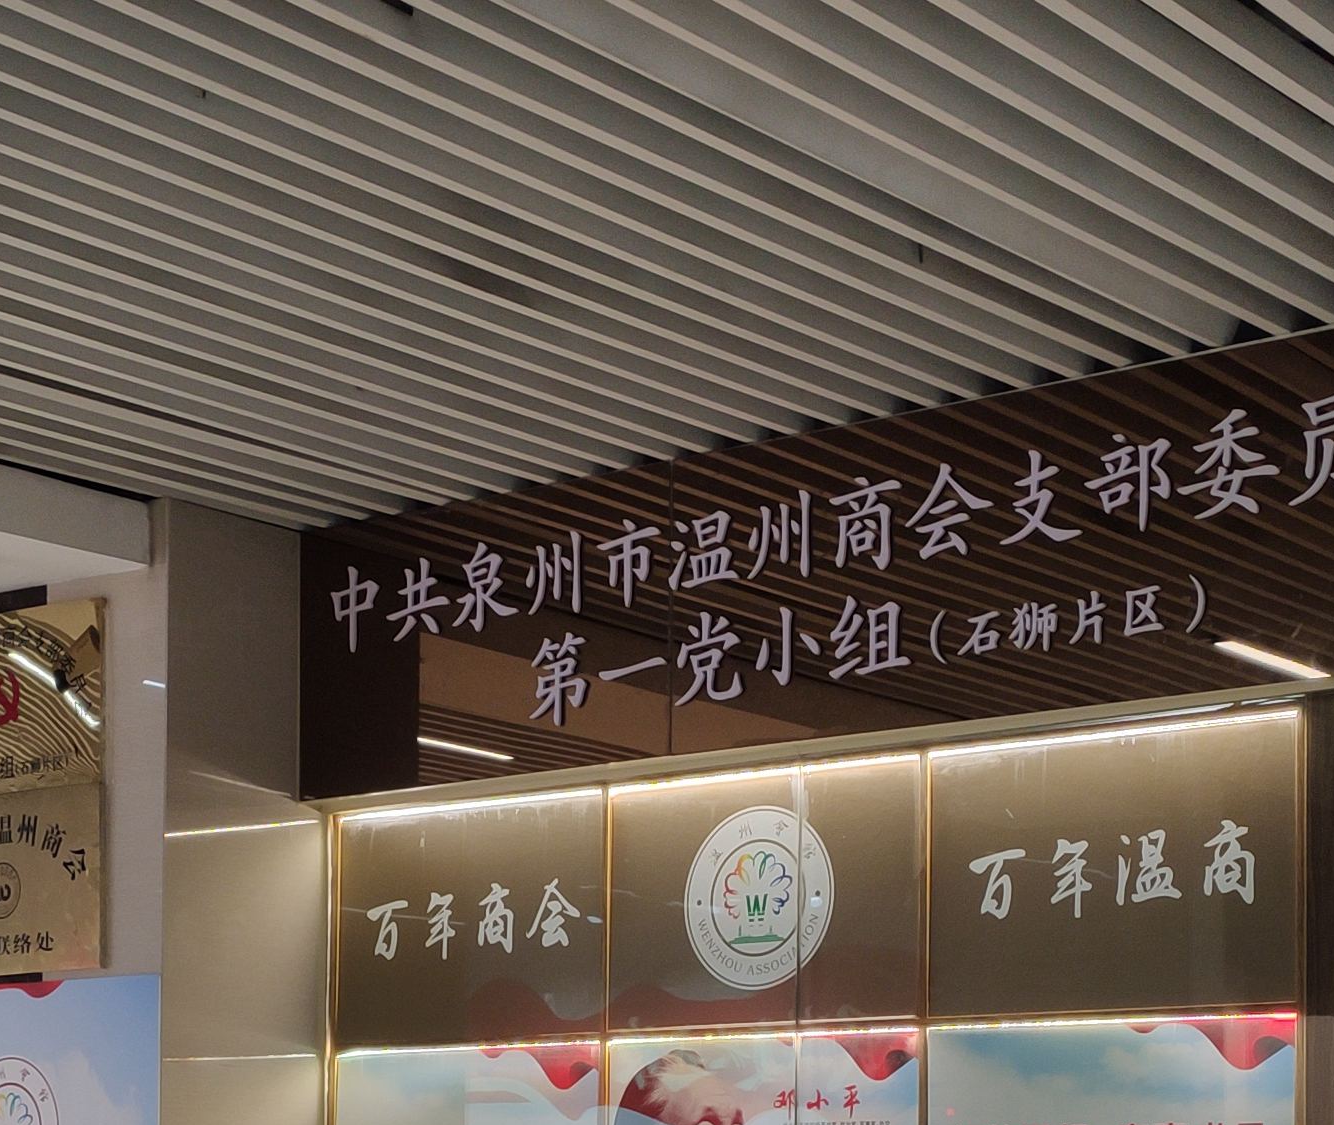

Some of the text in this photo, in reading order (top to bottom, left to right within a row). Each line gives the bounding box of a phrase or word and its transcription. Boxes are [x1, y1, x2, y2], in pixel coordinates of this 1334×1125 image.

[969, 819, 1255, 920] 百年温商
[366, 878, 581, 961] 百年商会
